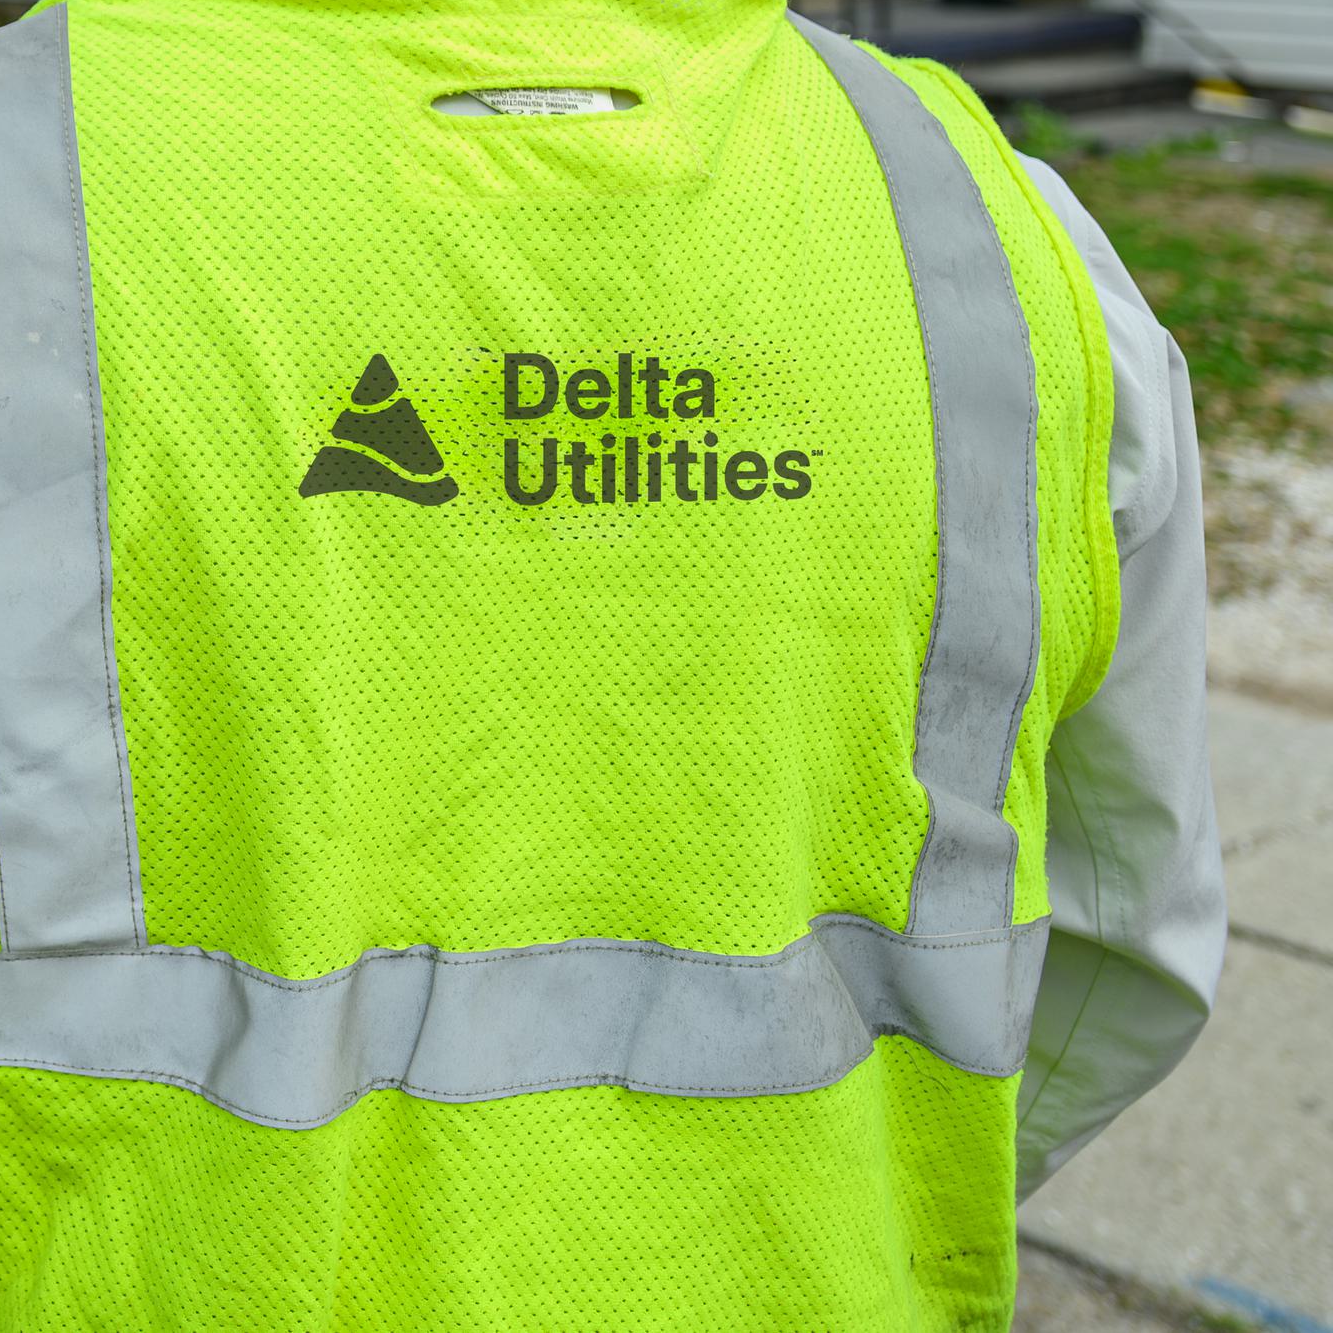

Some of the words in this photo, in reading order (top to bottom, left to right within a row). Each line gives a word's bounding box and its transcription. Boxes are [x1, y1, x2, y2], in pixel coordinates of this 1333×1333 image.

[491, 99, 544, 107] INSTRUCTIONS
[545, 102, 579, 110] WASHING
[504, 353, 715, 419] Delta
[504, 432, 812, 506] Utilities
